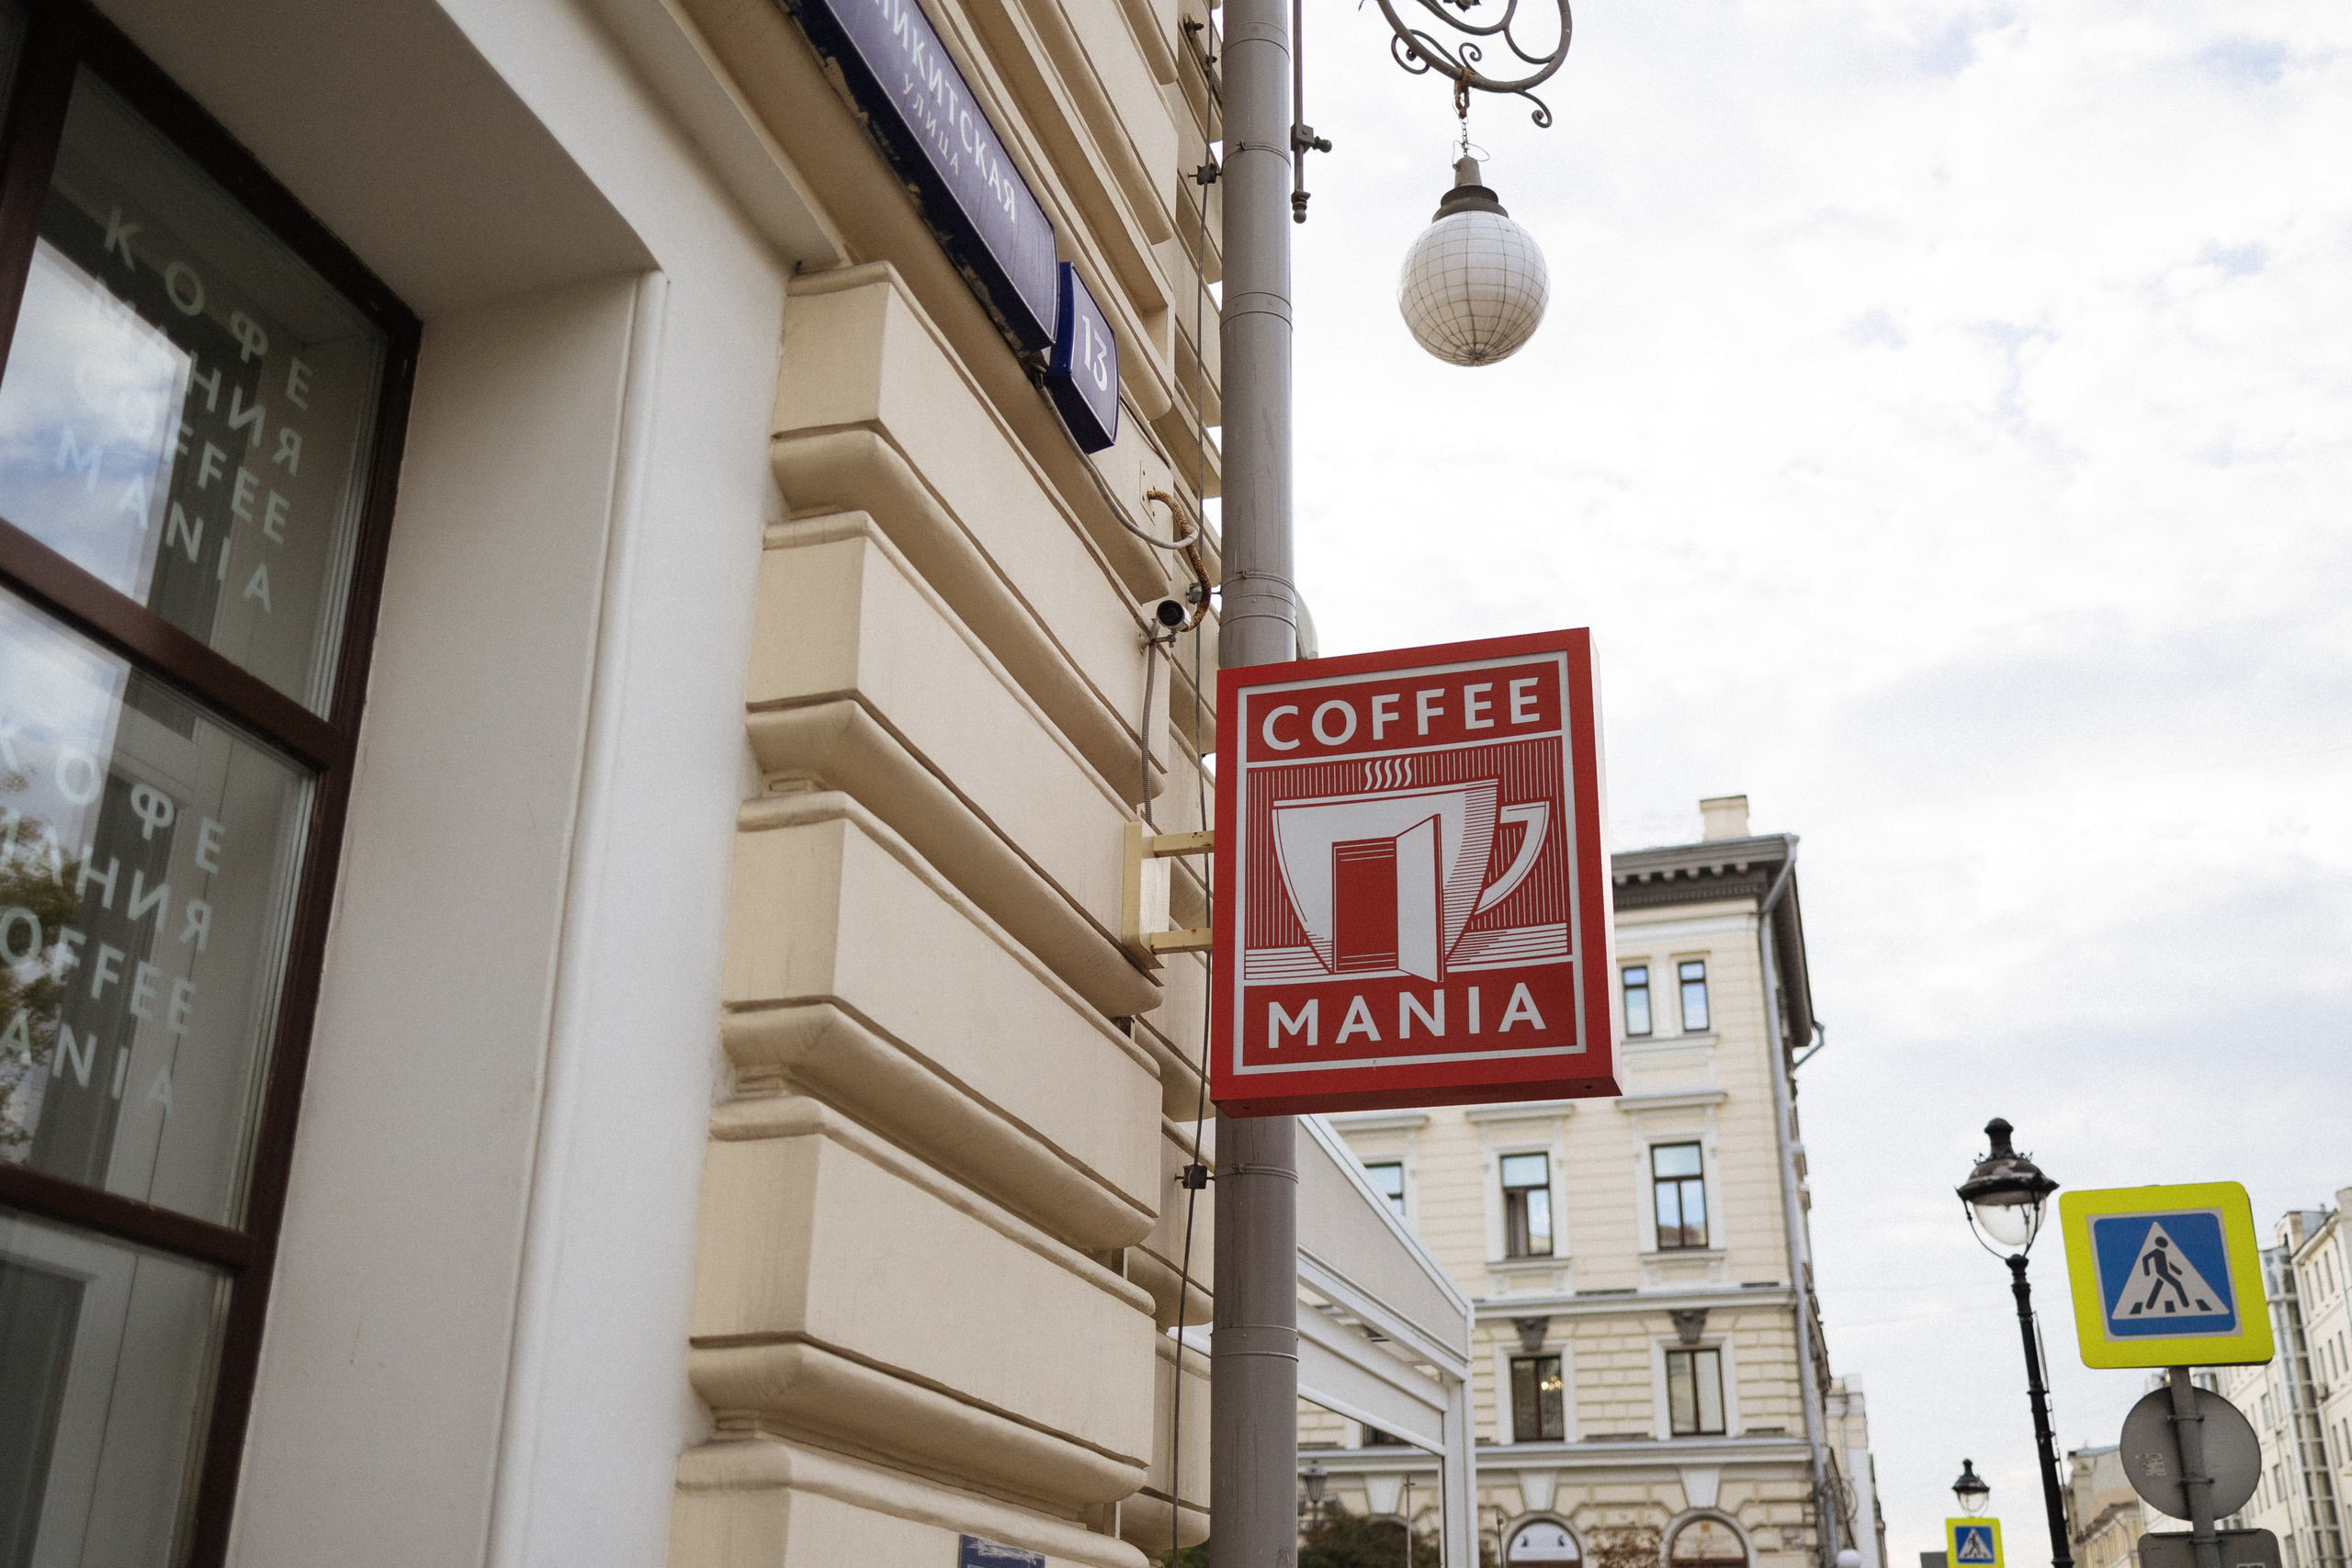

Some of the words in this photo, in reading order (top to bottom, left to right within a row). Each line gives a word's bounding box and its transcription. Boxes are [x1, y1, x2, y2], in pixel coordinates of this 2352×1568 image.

[903, 73, 958, 175] УЛИЦА
[104, 207, 313, 412] КОФЕ
[1082, 315, 1107, 391] 13
[56, 425, 272, 614] MANIA
[1262, 676, 1541, 751] COFFEE
[0, 908, 198, 1036] OFFEE
[1268, 982, 1546, 1049] MANIA
[0, 1009, 175, 1118] ANIA
